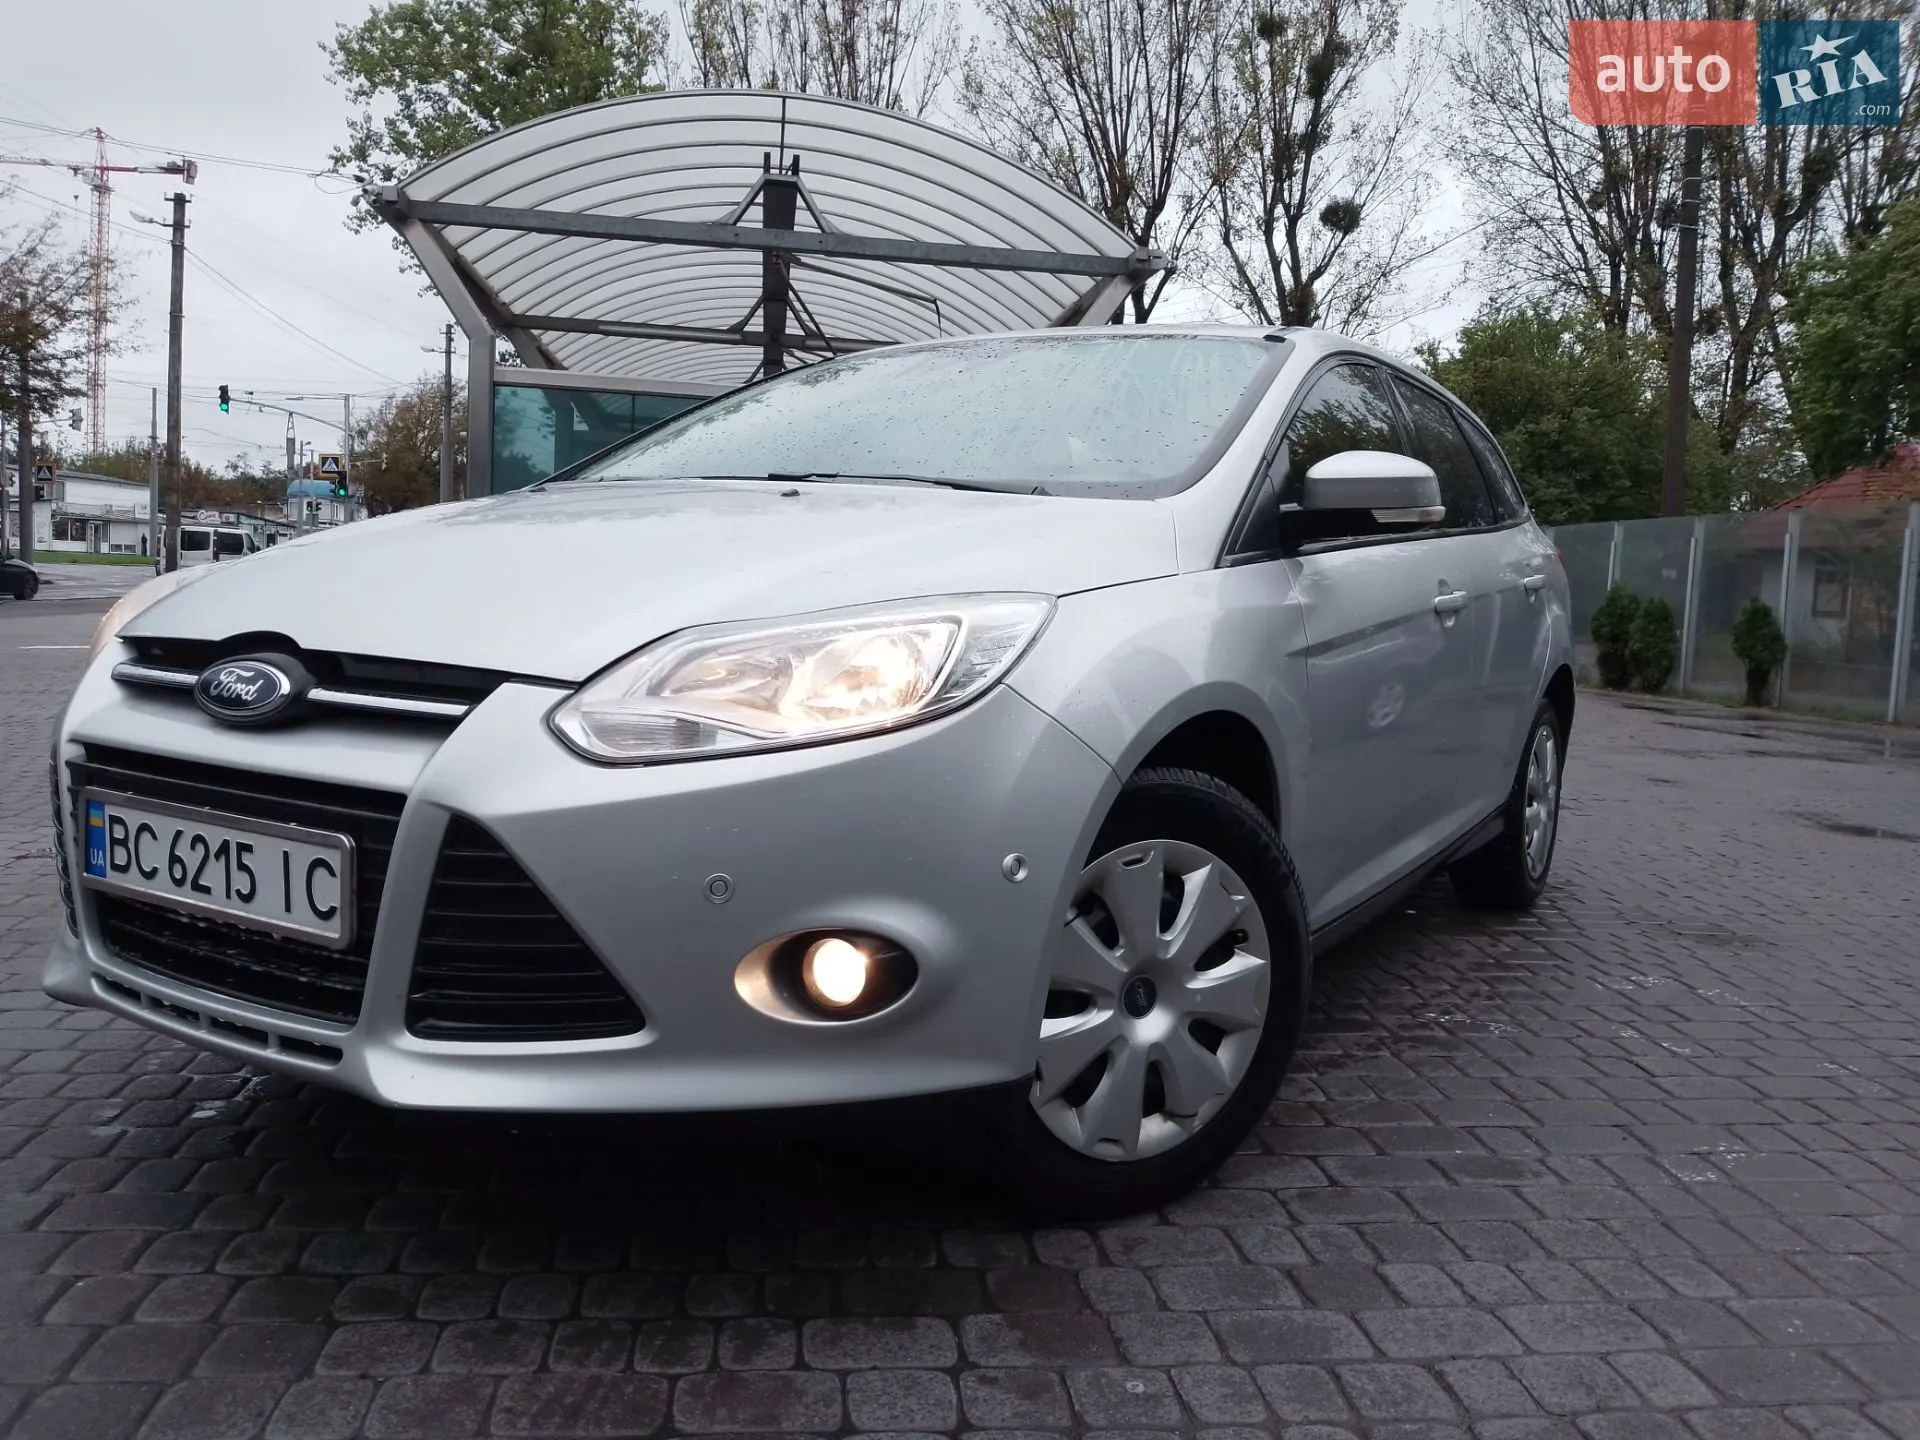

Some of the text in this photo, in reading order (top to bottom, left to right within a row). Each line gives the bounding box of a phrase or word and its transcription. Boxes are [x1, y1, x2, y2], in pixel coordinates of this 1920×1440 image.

[209, 667, 264, 701] Ford
[90, 847, 105, 867] UA
[108, 813, 337, 921] BC 6215 IC
